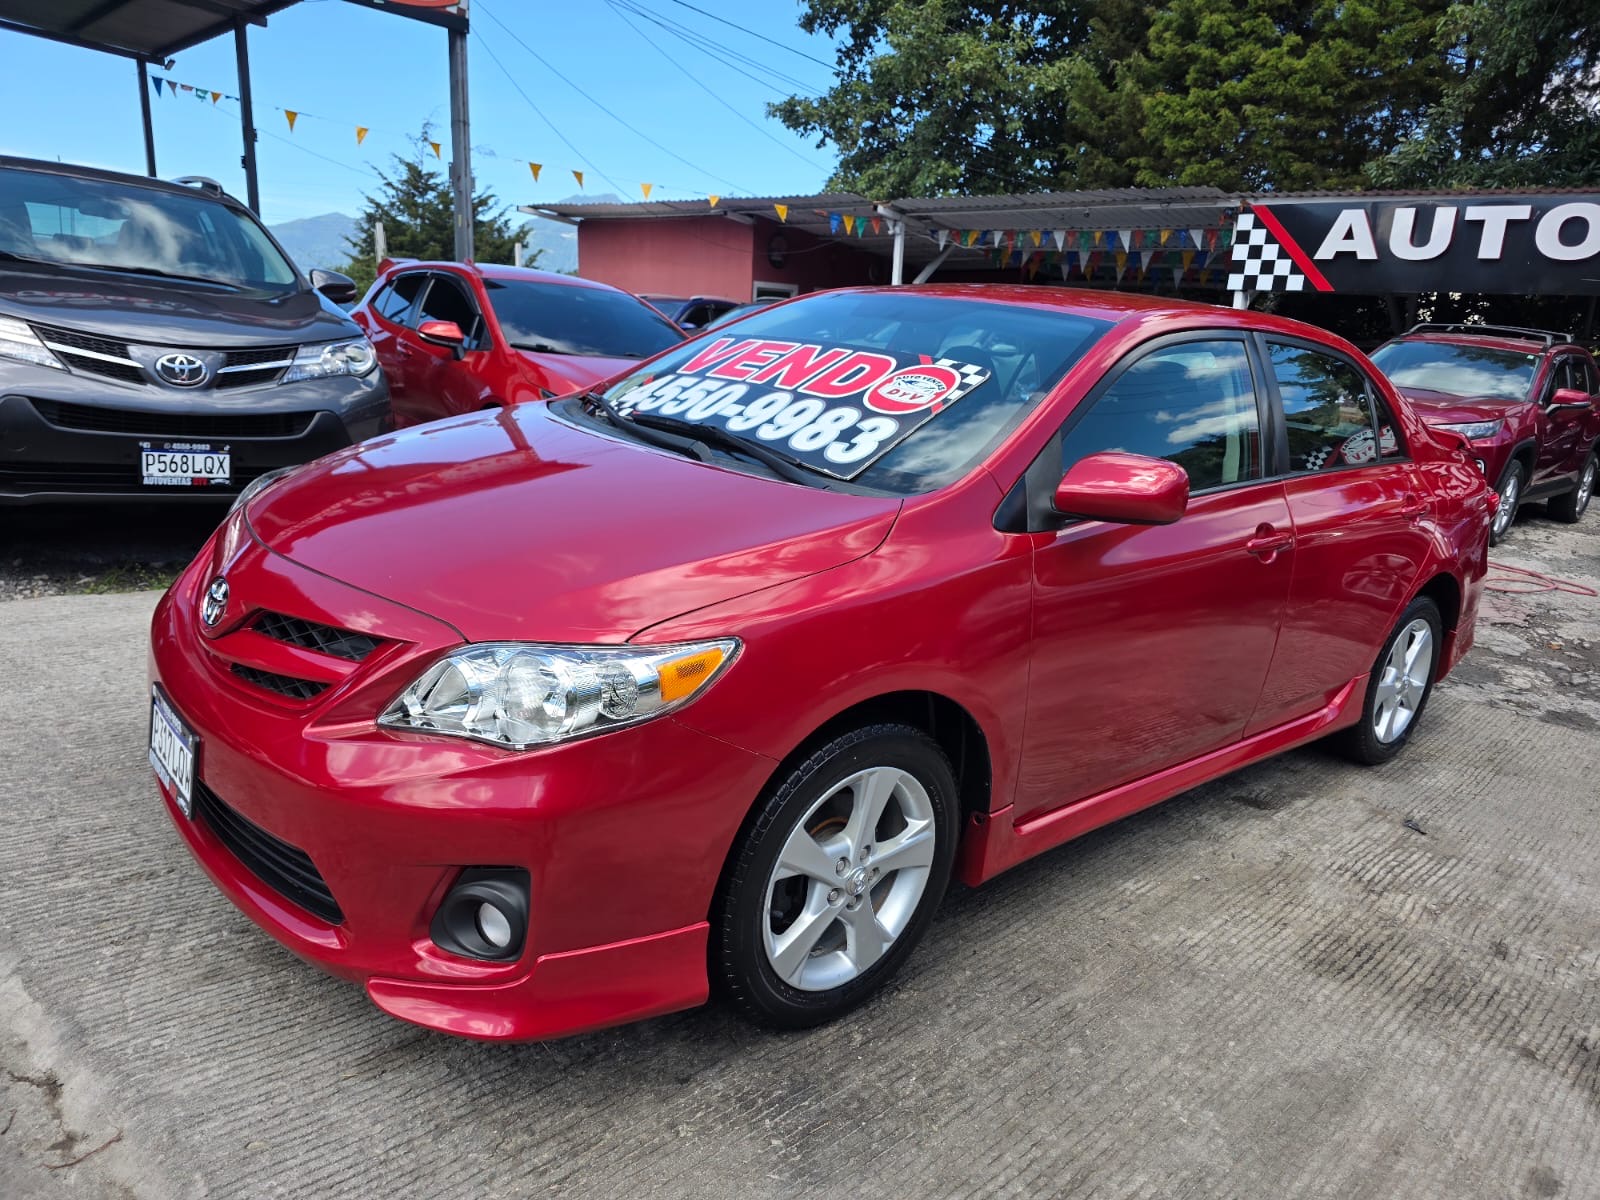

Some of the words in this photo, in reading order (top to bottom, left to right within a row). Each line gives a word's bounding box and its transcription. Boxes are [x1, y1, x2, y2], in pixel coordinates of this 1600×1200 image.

[1312, 202, 1600, 261] AUTO
[887, 388, 924, 401] DYV
[144, 453, 227, 475] P568LQX
